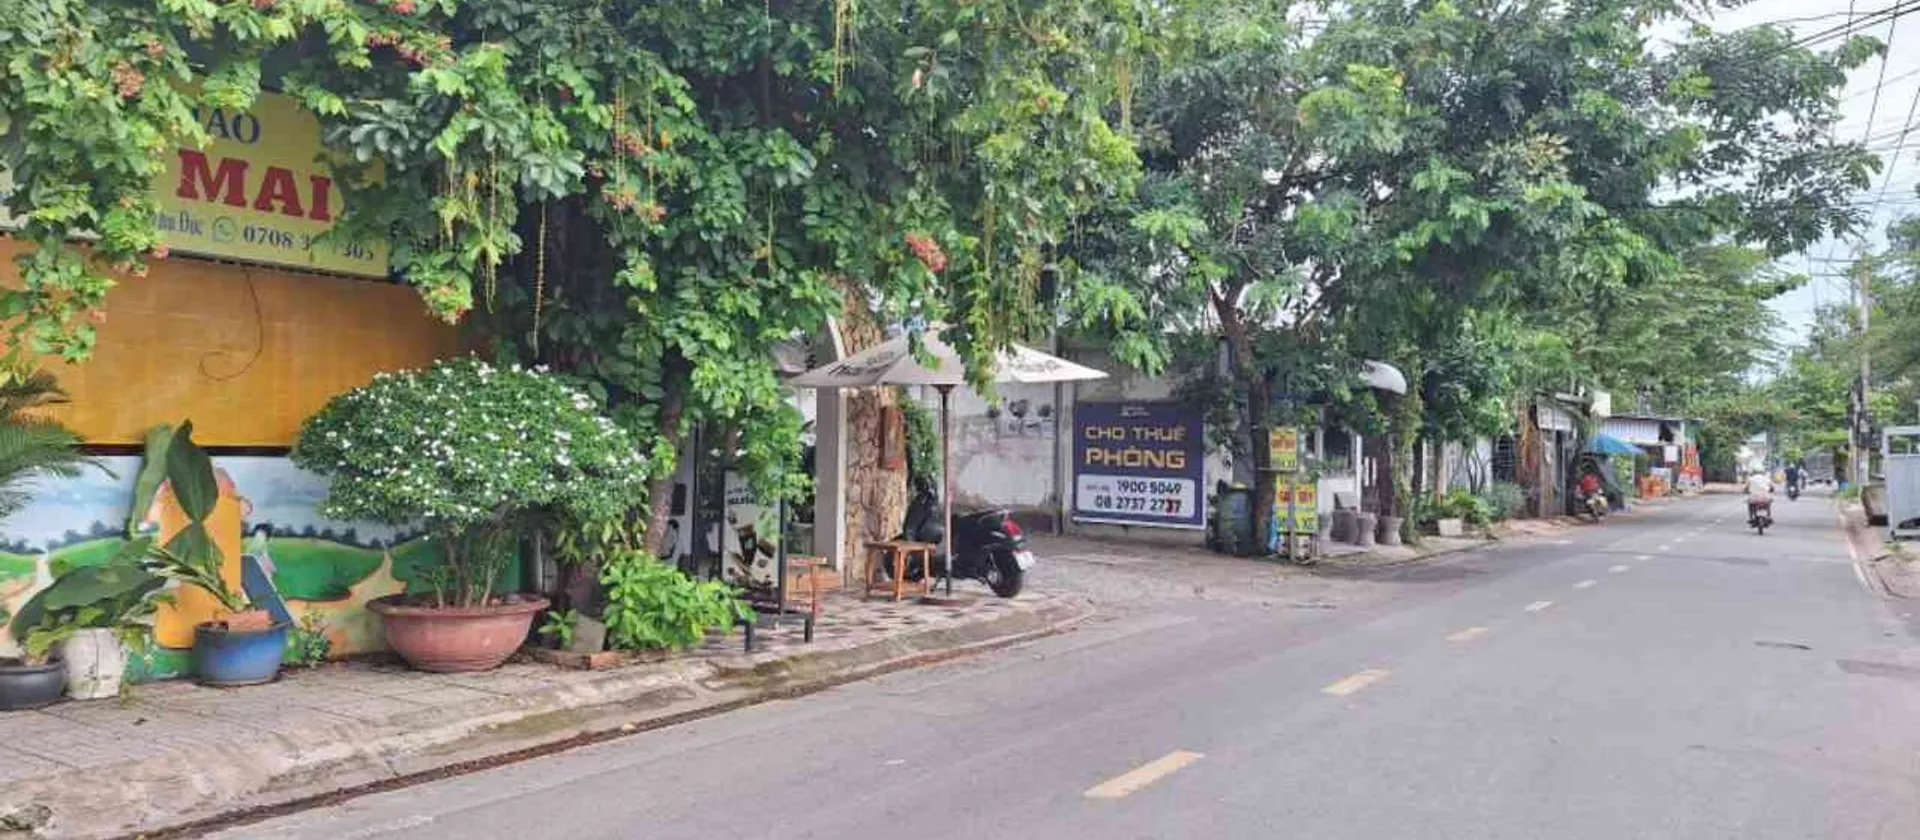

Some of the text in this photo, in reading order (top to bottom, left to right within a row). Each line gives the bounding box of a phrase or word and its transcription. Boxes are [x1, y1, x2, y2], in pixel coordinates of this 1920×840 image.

[243, 224, 293, 249] 0708
[1085, 426, 1125, 441] CHO
[1086, 445, 1186, 469] PHÒNG
[1117, 480, 1147, 493] 1900
[1149, 480, 1182, 494] 5049
